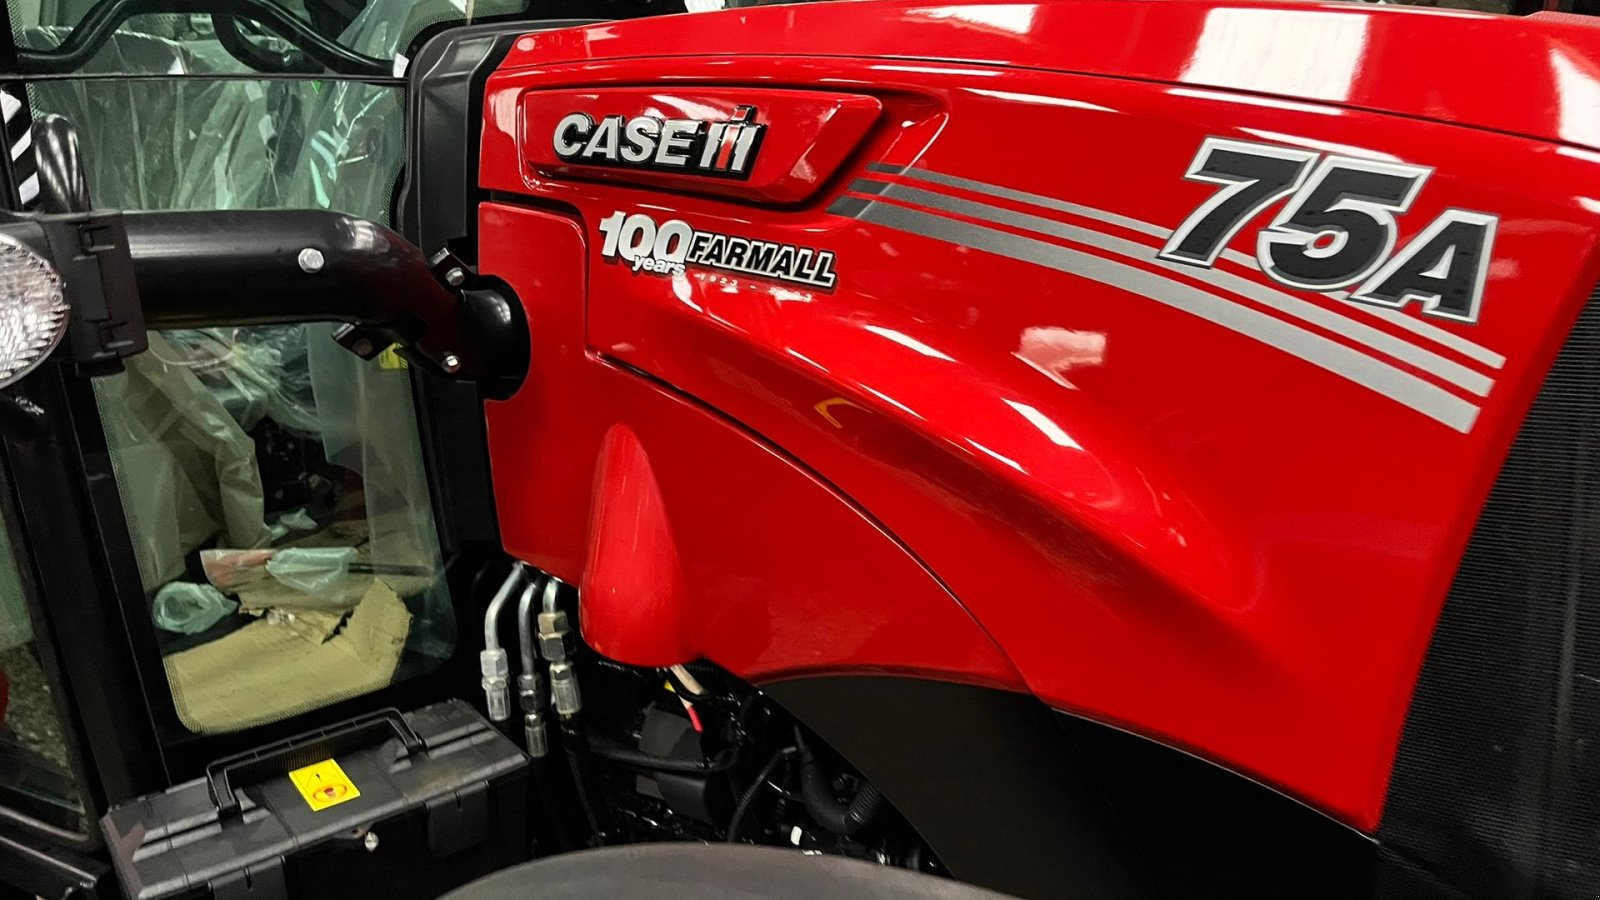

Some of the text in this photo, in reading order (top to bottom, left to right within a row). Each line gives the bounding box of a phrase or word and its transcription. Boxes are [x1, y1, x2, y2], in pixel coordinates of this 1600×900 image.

[553, 112, 704, 167] CASE
[599, 210, 837, 287] 100 FARMALL
[1156, 135, 1499, 325] 75A
[632, 254, 686, 276] years
